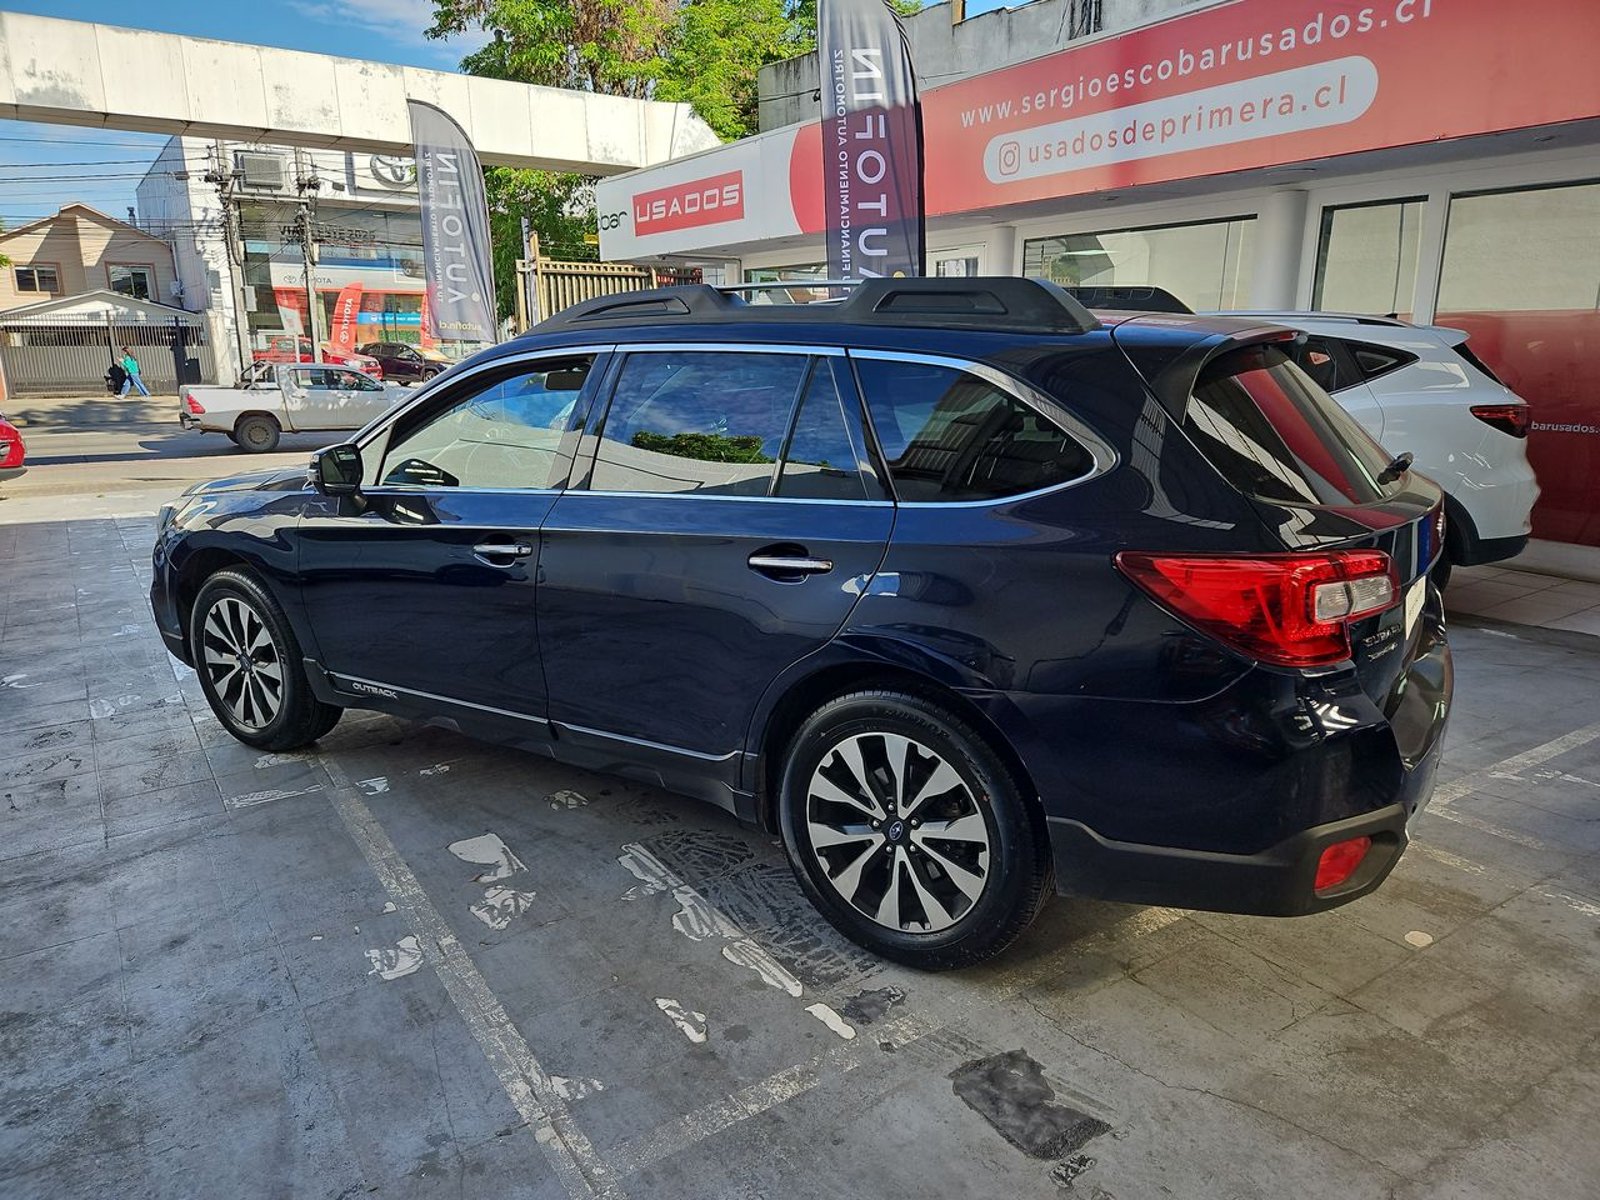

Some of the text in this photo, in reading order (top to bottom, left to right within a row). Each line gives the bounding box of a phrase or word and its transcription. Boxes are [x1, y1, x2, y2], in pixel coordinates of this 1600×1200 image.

[960, 0, 1433, 129] www.sergioescobarusados.cl
[1028, 74, 1347, 165] usadosdeprimera.cl
[636, 183, 740, 223] USADOS
[341, 298, 354, 330] TOYOTA
[1531, 420, 1600, 434] barusados.
[352, 682, 399, 700] OUTBACK
